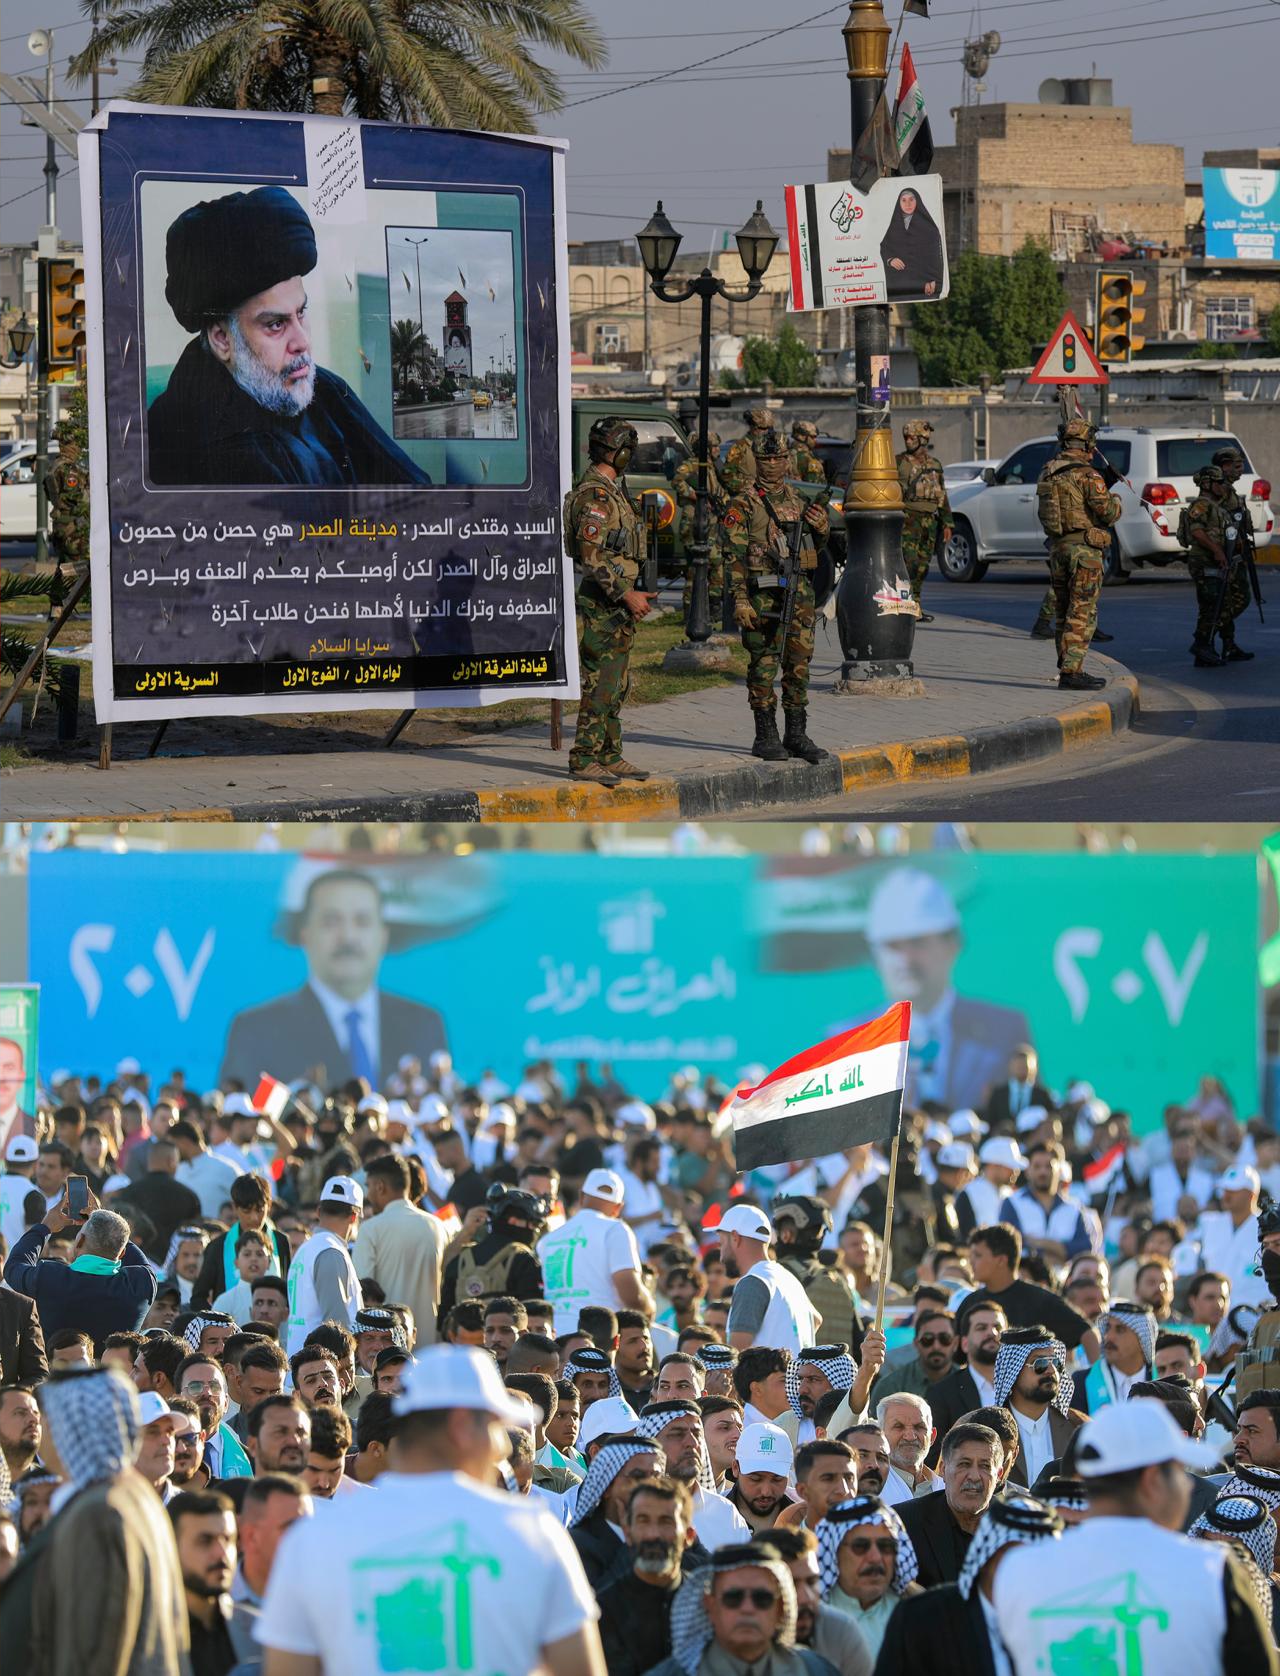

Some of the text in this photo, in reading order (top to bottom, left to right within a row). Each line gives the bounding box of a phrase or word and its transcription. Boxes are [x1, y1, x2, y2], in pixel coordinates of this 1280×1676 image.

[119, 522, 176, 544] حصون
[183, 522, 207, 542] من
[213, 521, 256, 542] حصن
[263, 523, 294, 546] هي
[299, 518, 343, 542] الصدر
[349, 518, 398, 541] مدينة
[411, 518, 453, 541] الصدر
[458, 518, 508, 539] مقتدى
[514, 517, 555, 540] السيد
[123, 567, 189, 586] وبرص
[195, 561, 246, 580] العنف
[253, 565, 309, 584] بعدم
[402, 558, 432, 581] لكن
[437, 558, 478, 582] الصدر
[483, 555, 508, 581] وآل
[512, 557, 555, 581] العراق
[211, 593, 557, 627] الصفوف وترك الدنيا لأهلها فنحن طلاب آخرة
[309, 638, 390, 660] سرايا السلام
[282, 668, 309, 686] الاول
[311, 666, 339, 685] الفوج
[355, 665, 381, 684] الاول
[382, 664, 402, 681] لواء
[484, 659, 518, 678] الفرقة
[520, 657, 548, 677] قيادة
[135, 671, 219, 691] السرية الاولى
[68, 922, 217, 1023] ٢٠٧
[1052, 925, 1210, 1028] ٢٠٧
[839, 1064, 864, 1092] الله
